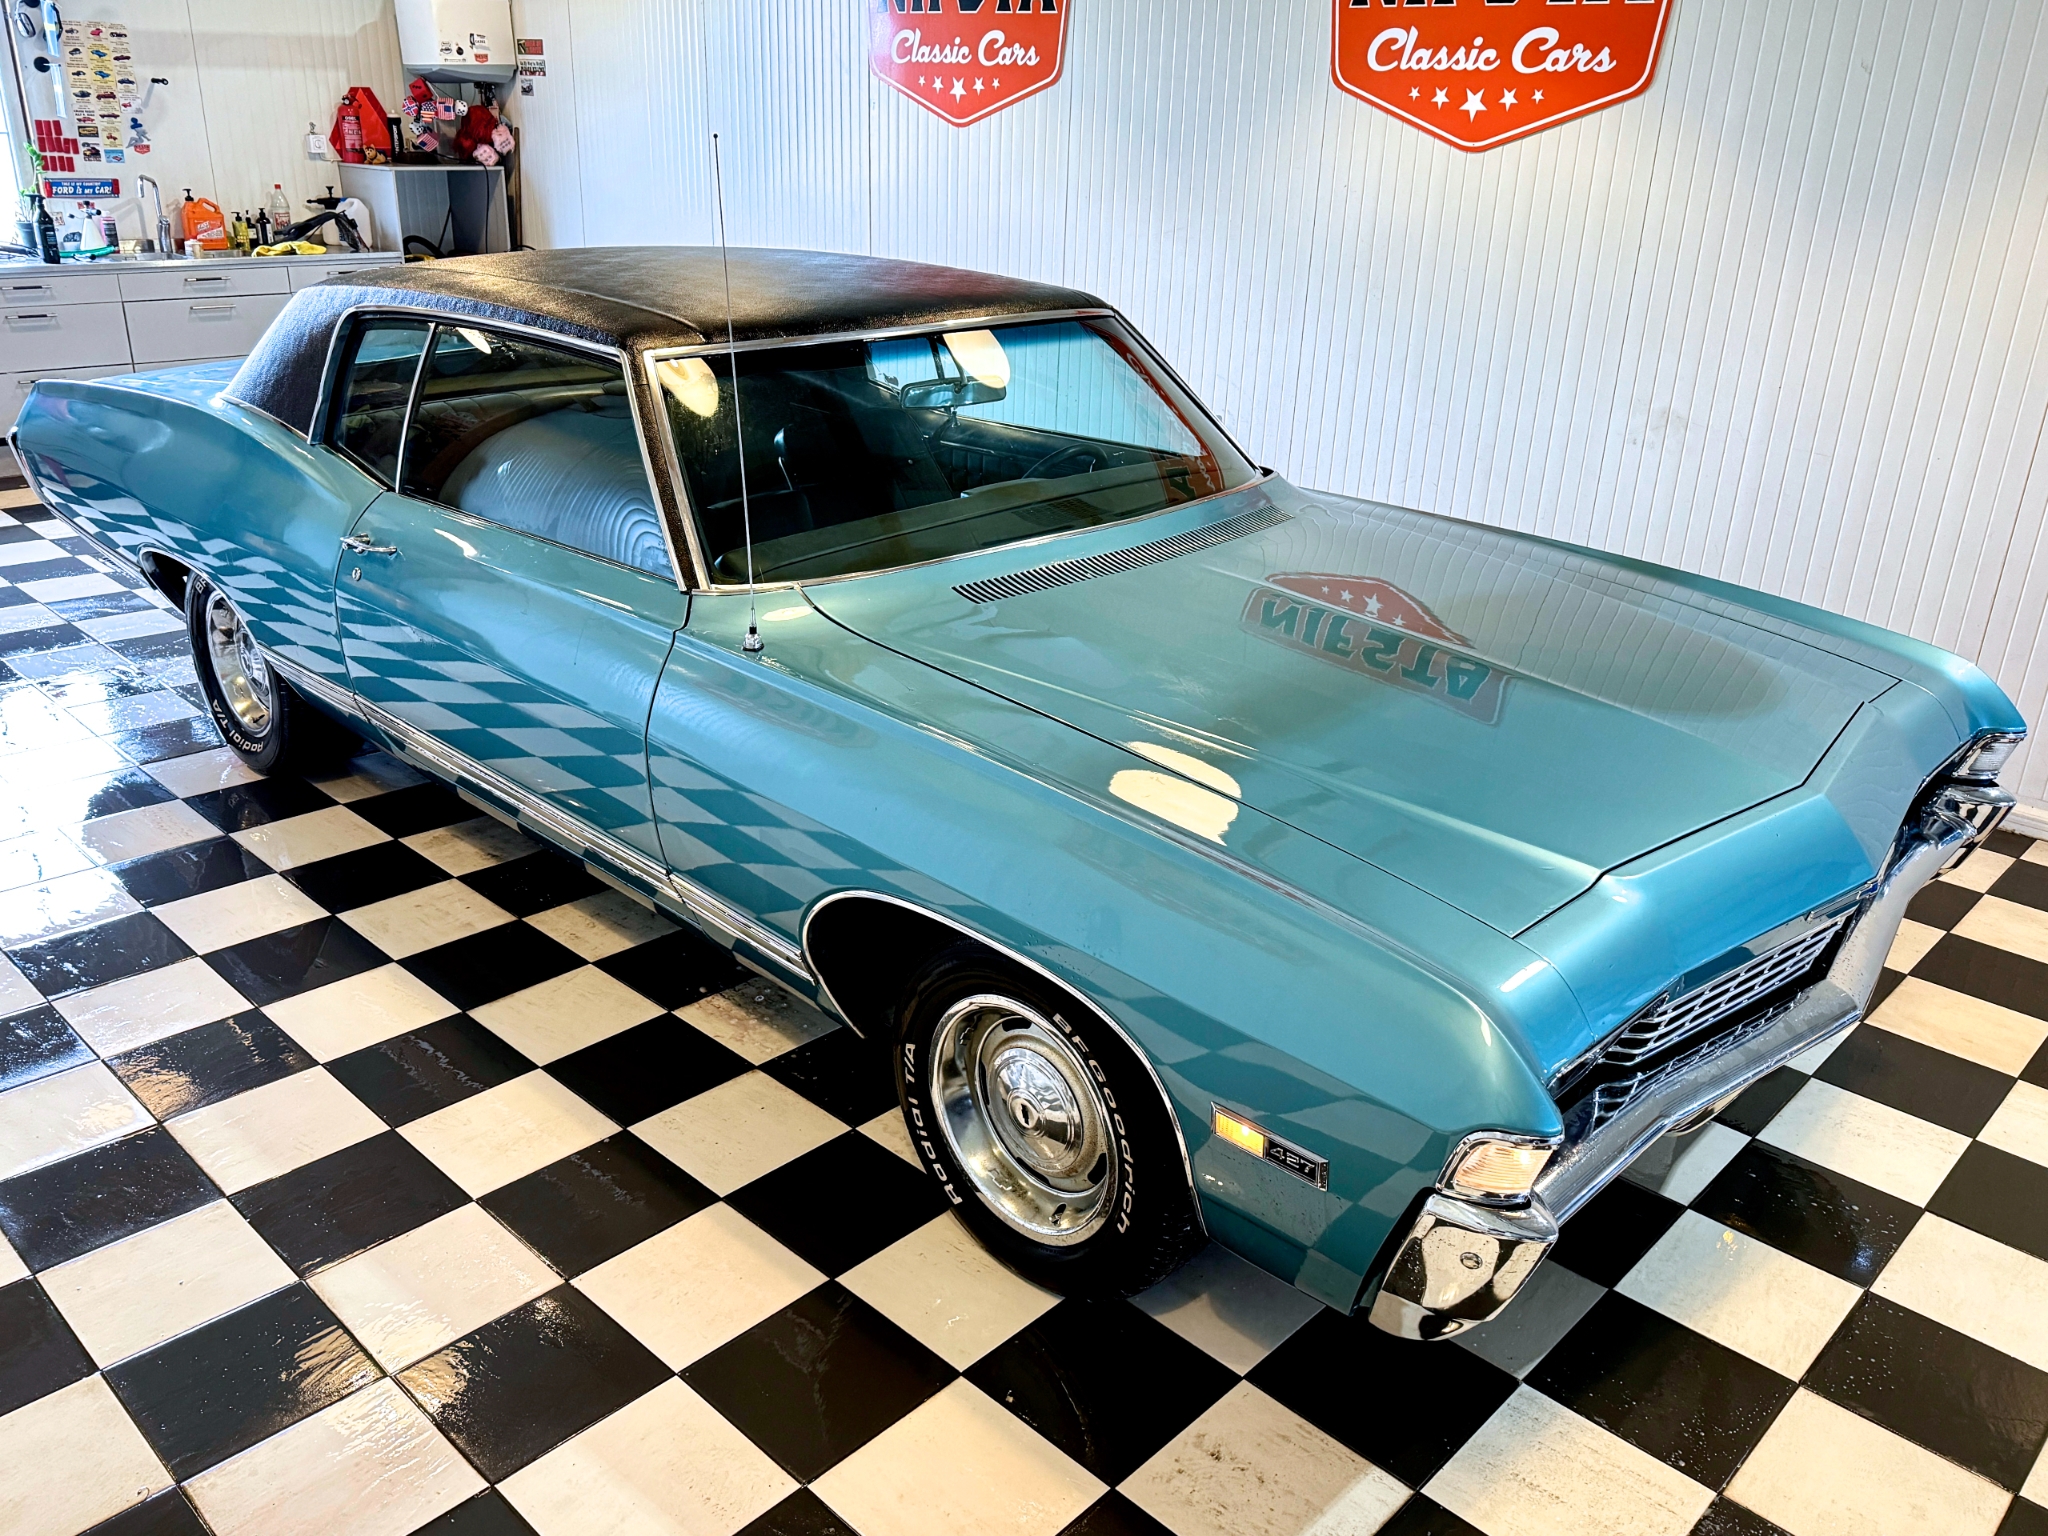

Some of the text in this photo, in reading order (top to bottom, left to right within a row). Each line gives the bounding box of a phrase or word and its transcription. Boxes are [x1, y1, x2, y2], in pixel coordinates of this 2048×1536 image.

[891, 28, 1040, 66] Classic Cars
[1367, 25, 1617, 74] Classic Cars
[52, 186, 74, 194] FORD
[95, 186, 112, 194] CAR!
[213, 699, 228, 728] T/A
[904, 1043, 963, 1205] Radial T/A
[1052, 1013, 1136, 1234] BFGoodrich
[1270, 1147, 1316, 1173] 427
